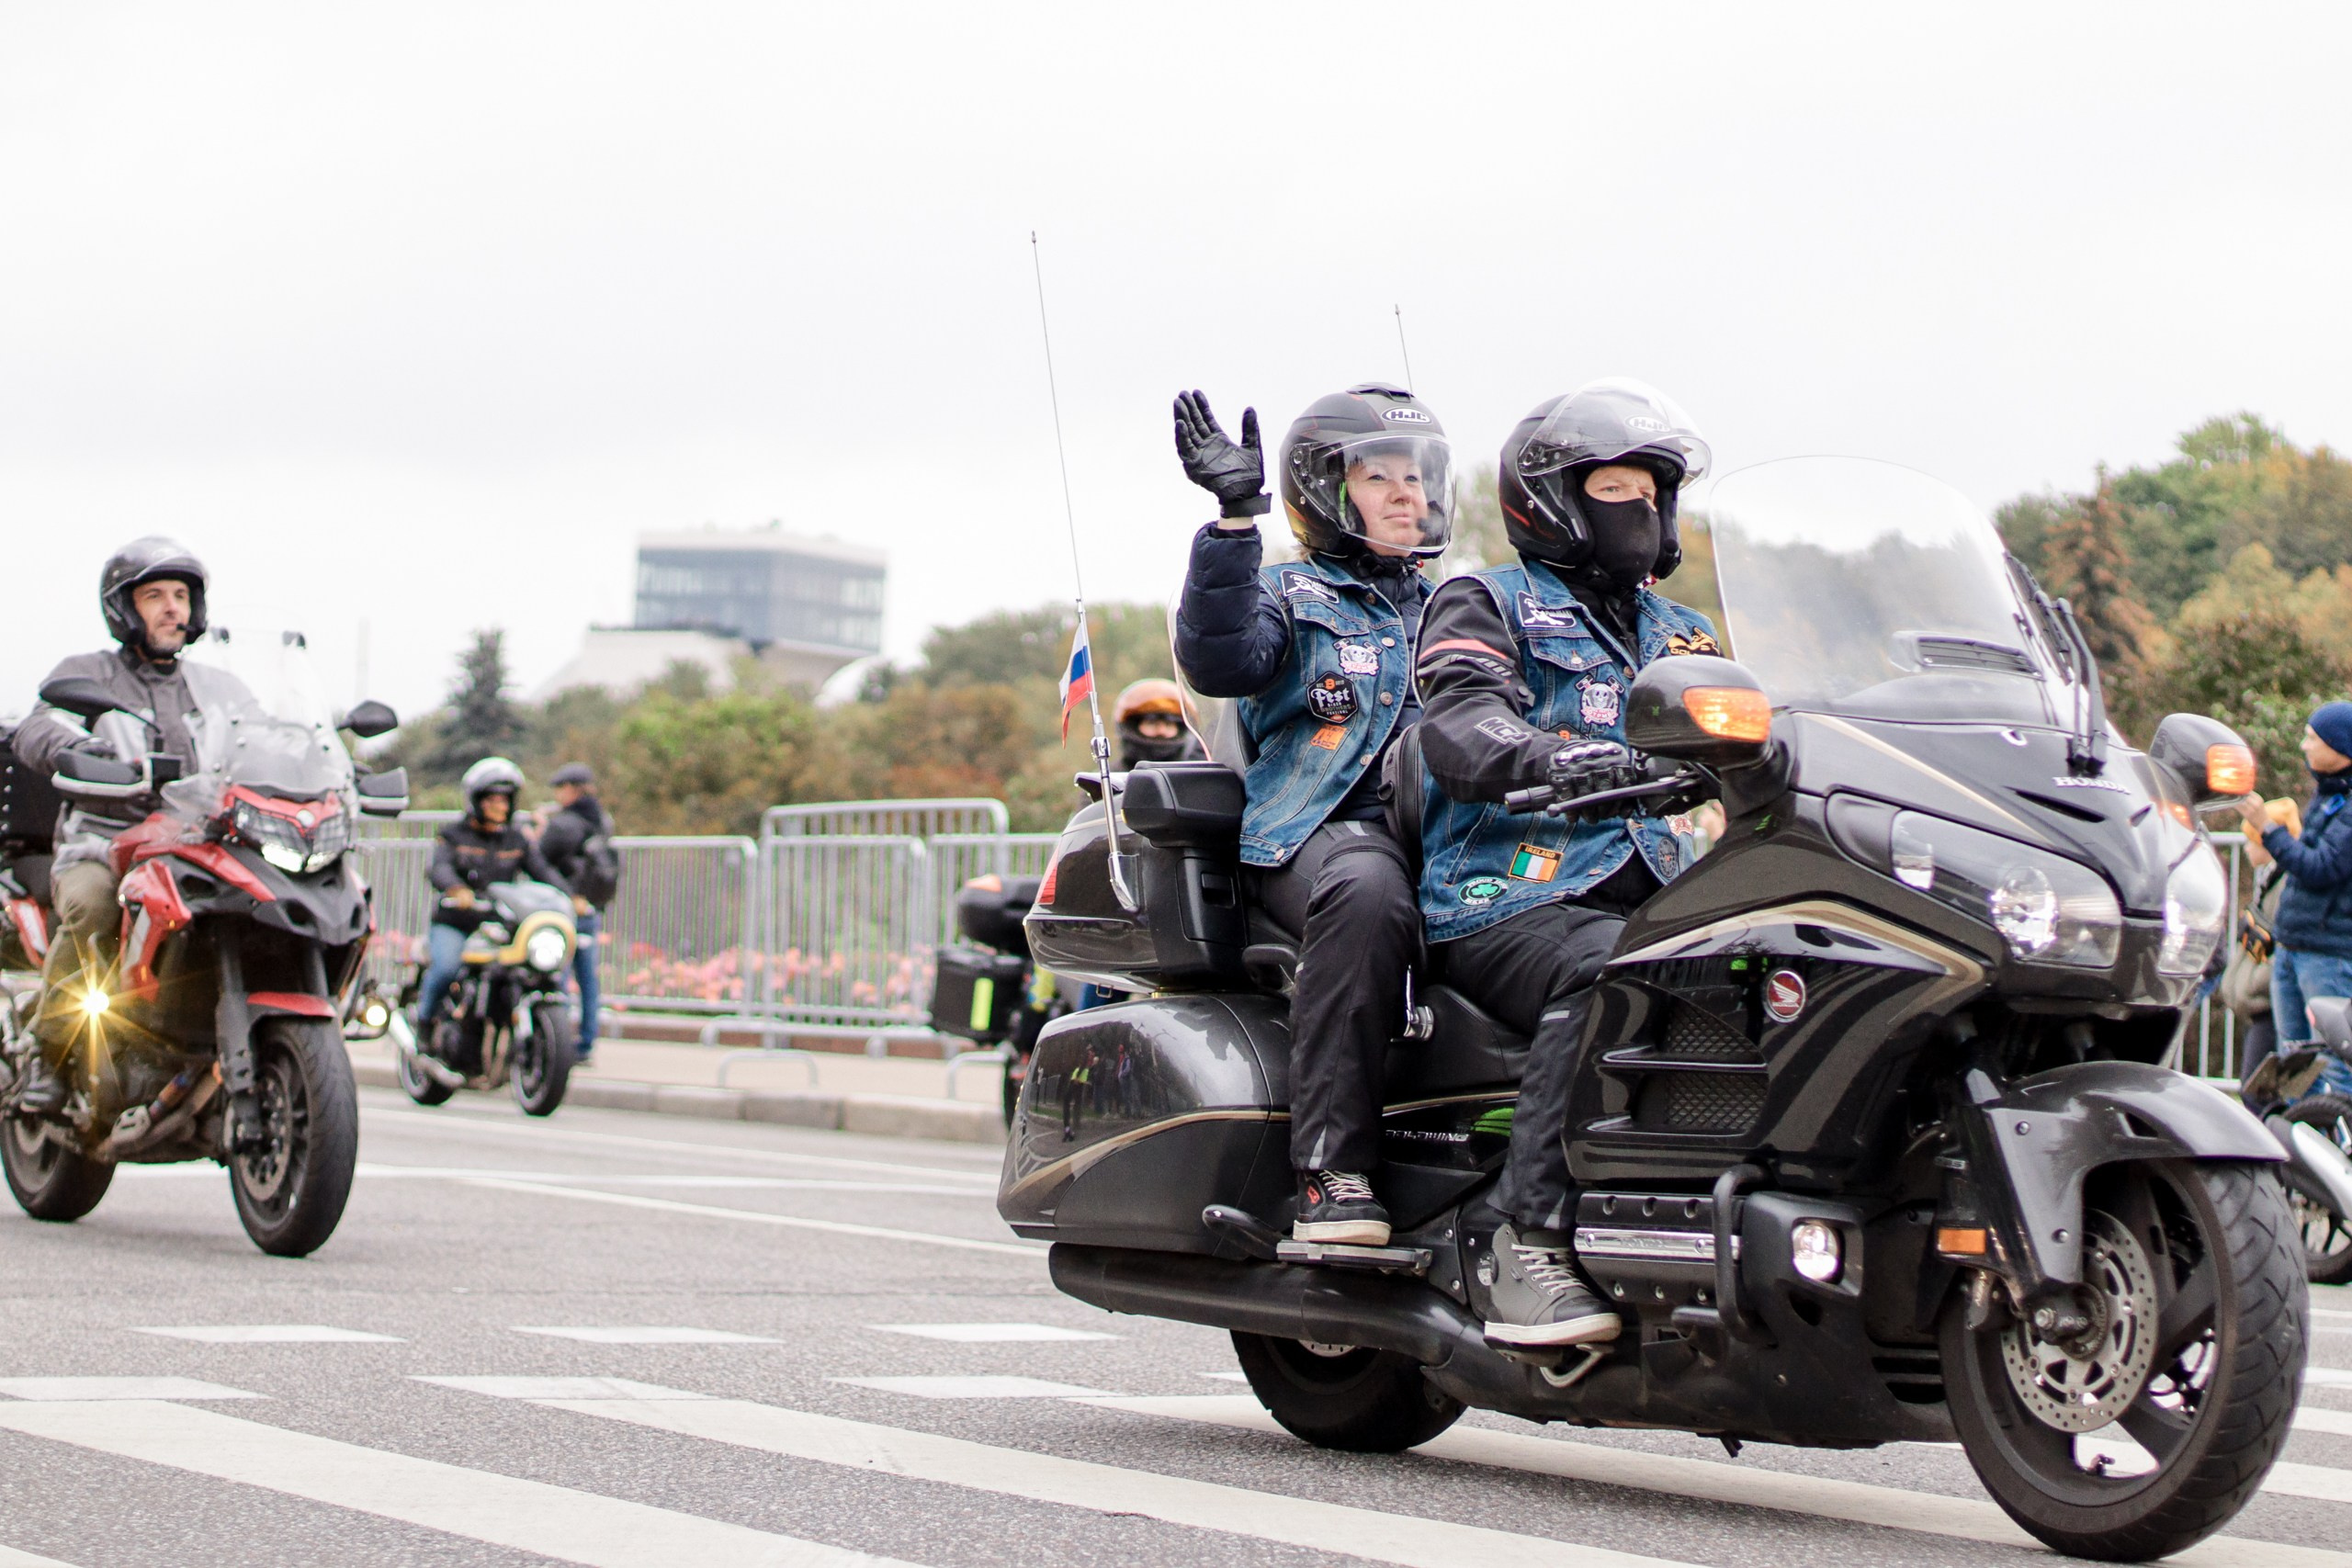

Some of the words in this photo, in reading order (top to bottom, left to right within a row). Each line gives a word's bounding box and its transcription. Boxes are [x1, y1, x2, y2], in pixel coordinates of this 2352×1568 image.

[1390, 410, 1427, 422] HJC
[1310, 687, 1351, 710] Fest
[2052, 776, 2131, 795] HONDA
[1525, 846, 1556, 858] IRELAND
